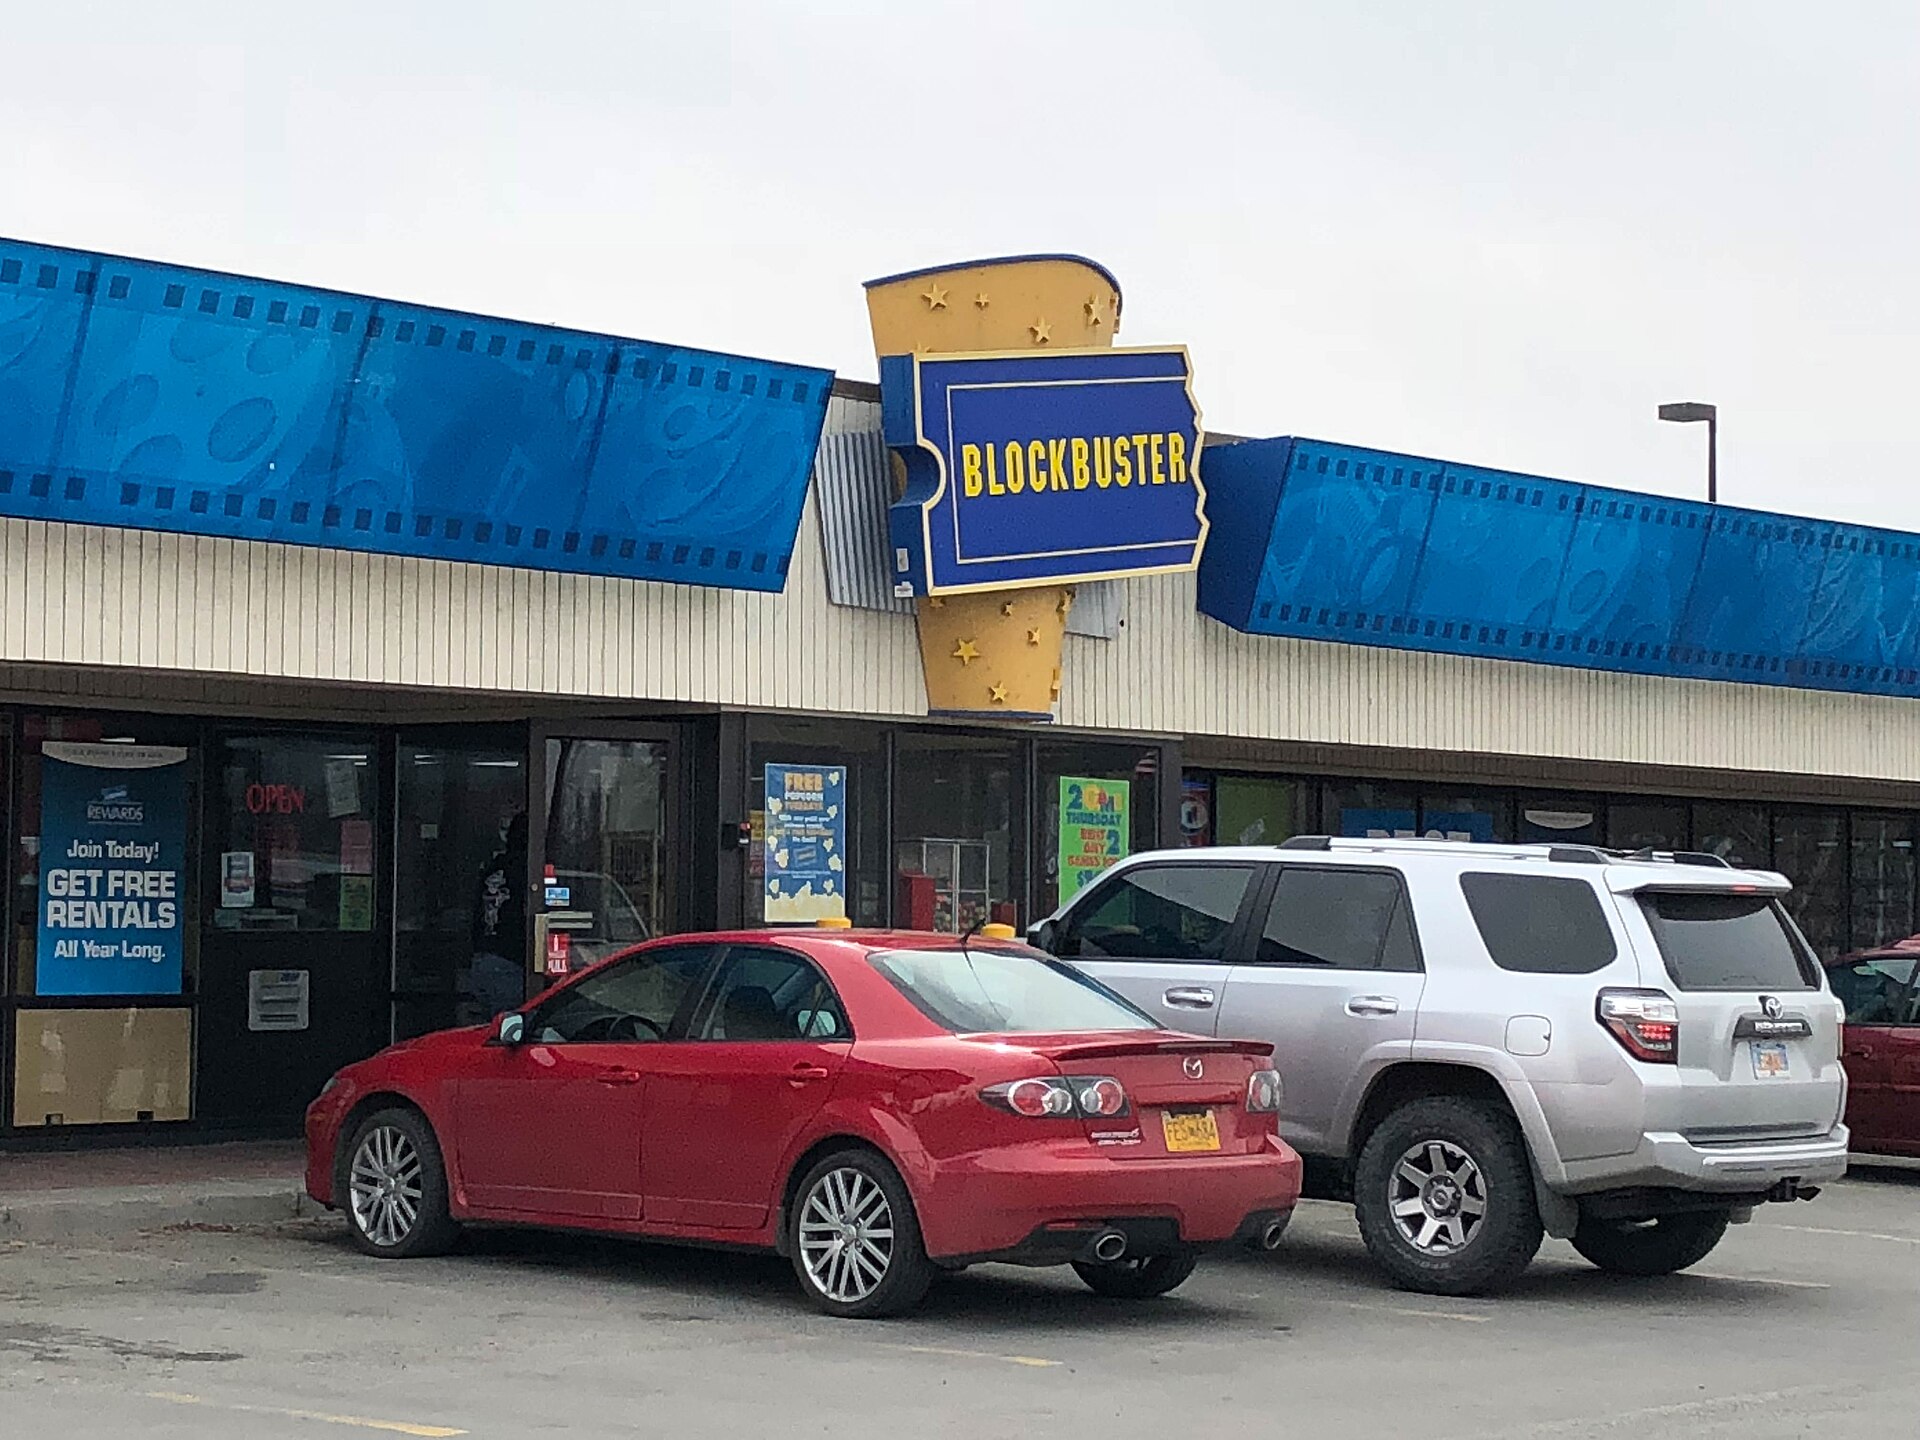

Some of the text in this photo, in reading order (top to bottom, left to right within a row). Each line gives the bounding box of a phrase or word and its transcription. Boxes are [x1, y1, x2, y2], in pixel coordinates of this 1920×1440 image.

[962, 431, 1187, 498] BLOCKBUSTER
[784, 773, 823, 791] FREE
[246, 783, 304, 814] OPEN
[1068, 784, 1083, 809] 2
[87, 805, 143, 820] REWARDS
[67, 839, 159, 863] Join Today!
[47, 869, 176, 898] GET FREE
[47, 900, 176, 928] RENTALS
[54, 939, 166, 963] All Year Long.
